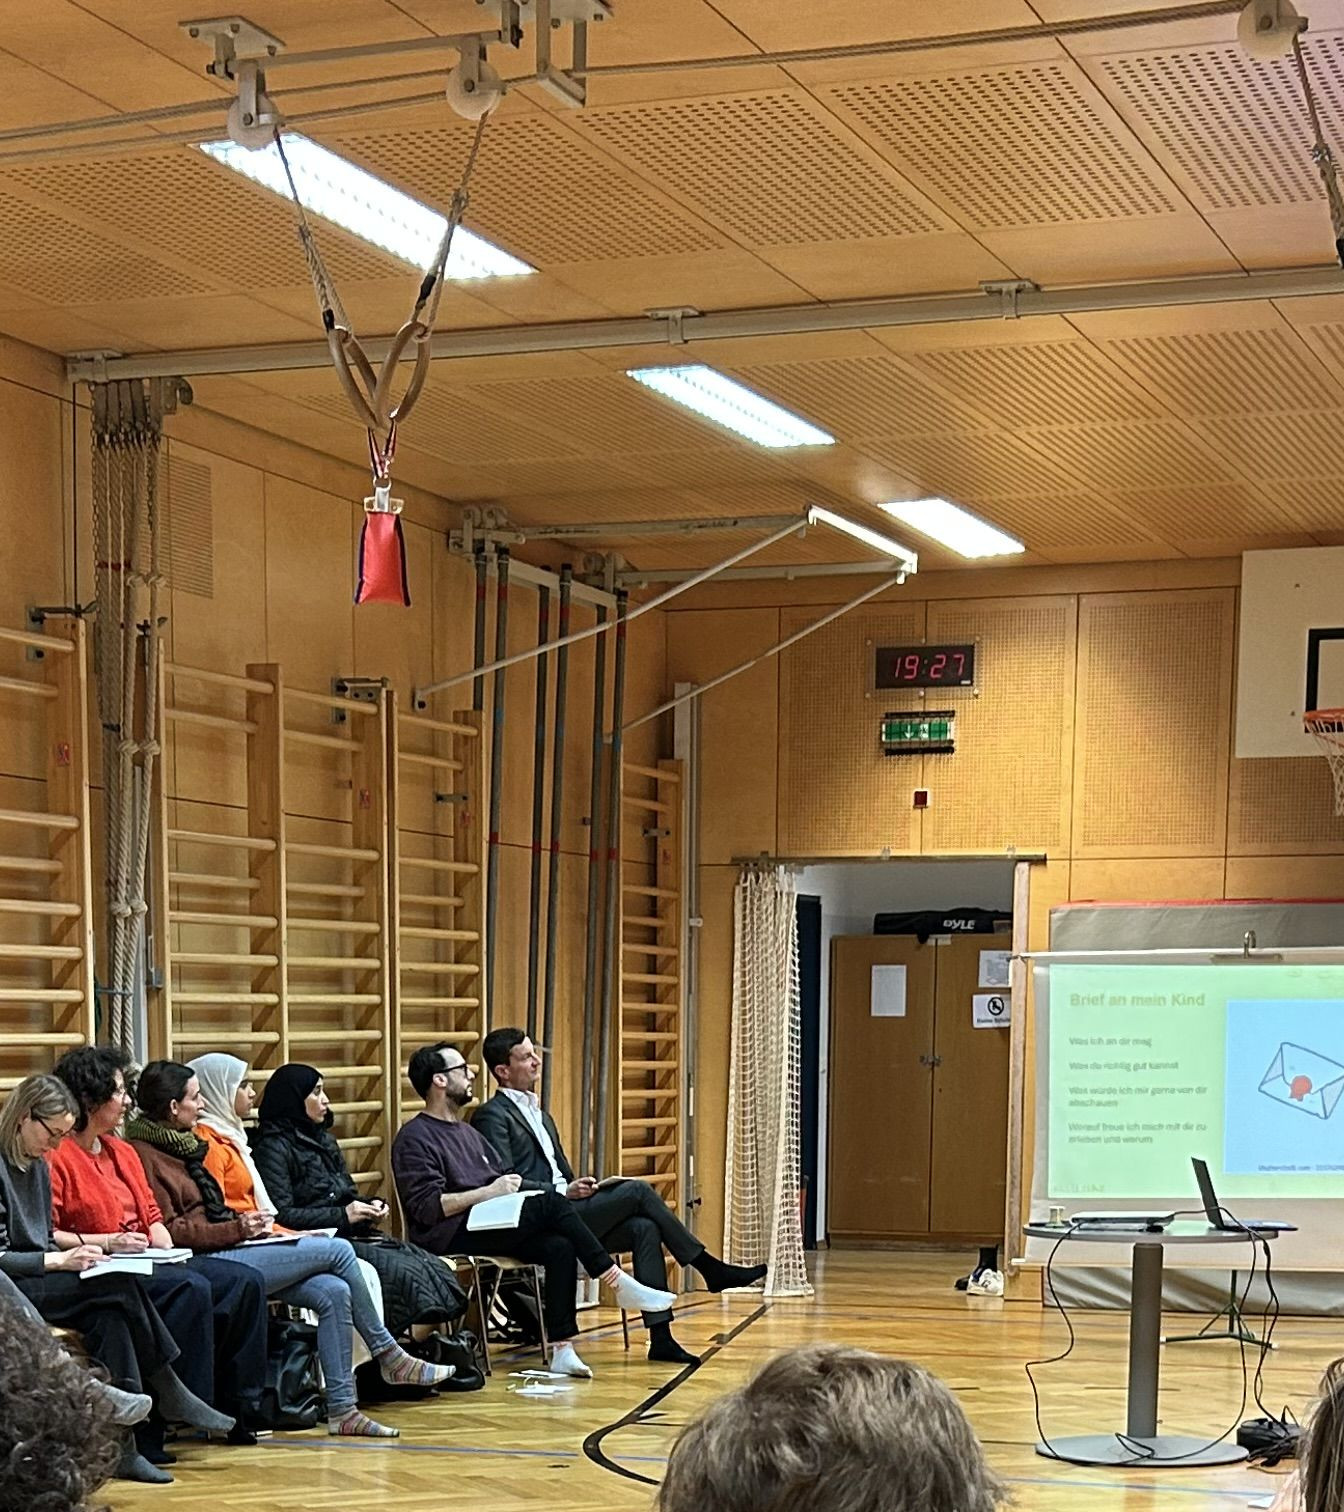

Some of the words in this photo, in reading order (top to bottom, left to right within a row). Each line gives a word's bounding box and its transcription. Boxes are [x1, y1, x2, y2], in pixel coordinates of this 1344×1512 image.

[895, 654, 965, 679] 19:27
[943, 919, 976, 930] PYLE
[1069, 992, 1105, 1007] Brief
[1109, 995, 1127, 1007] an
[1131, 995, 1167, 1007] mein
[1171, 992, 1206, 1007] Kind
